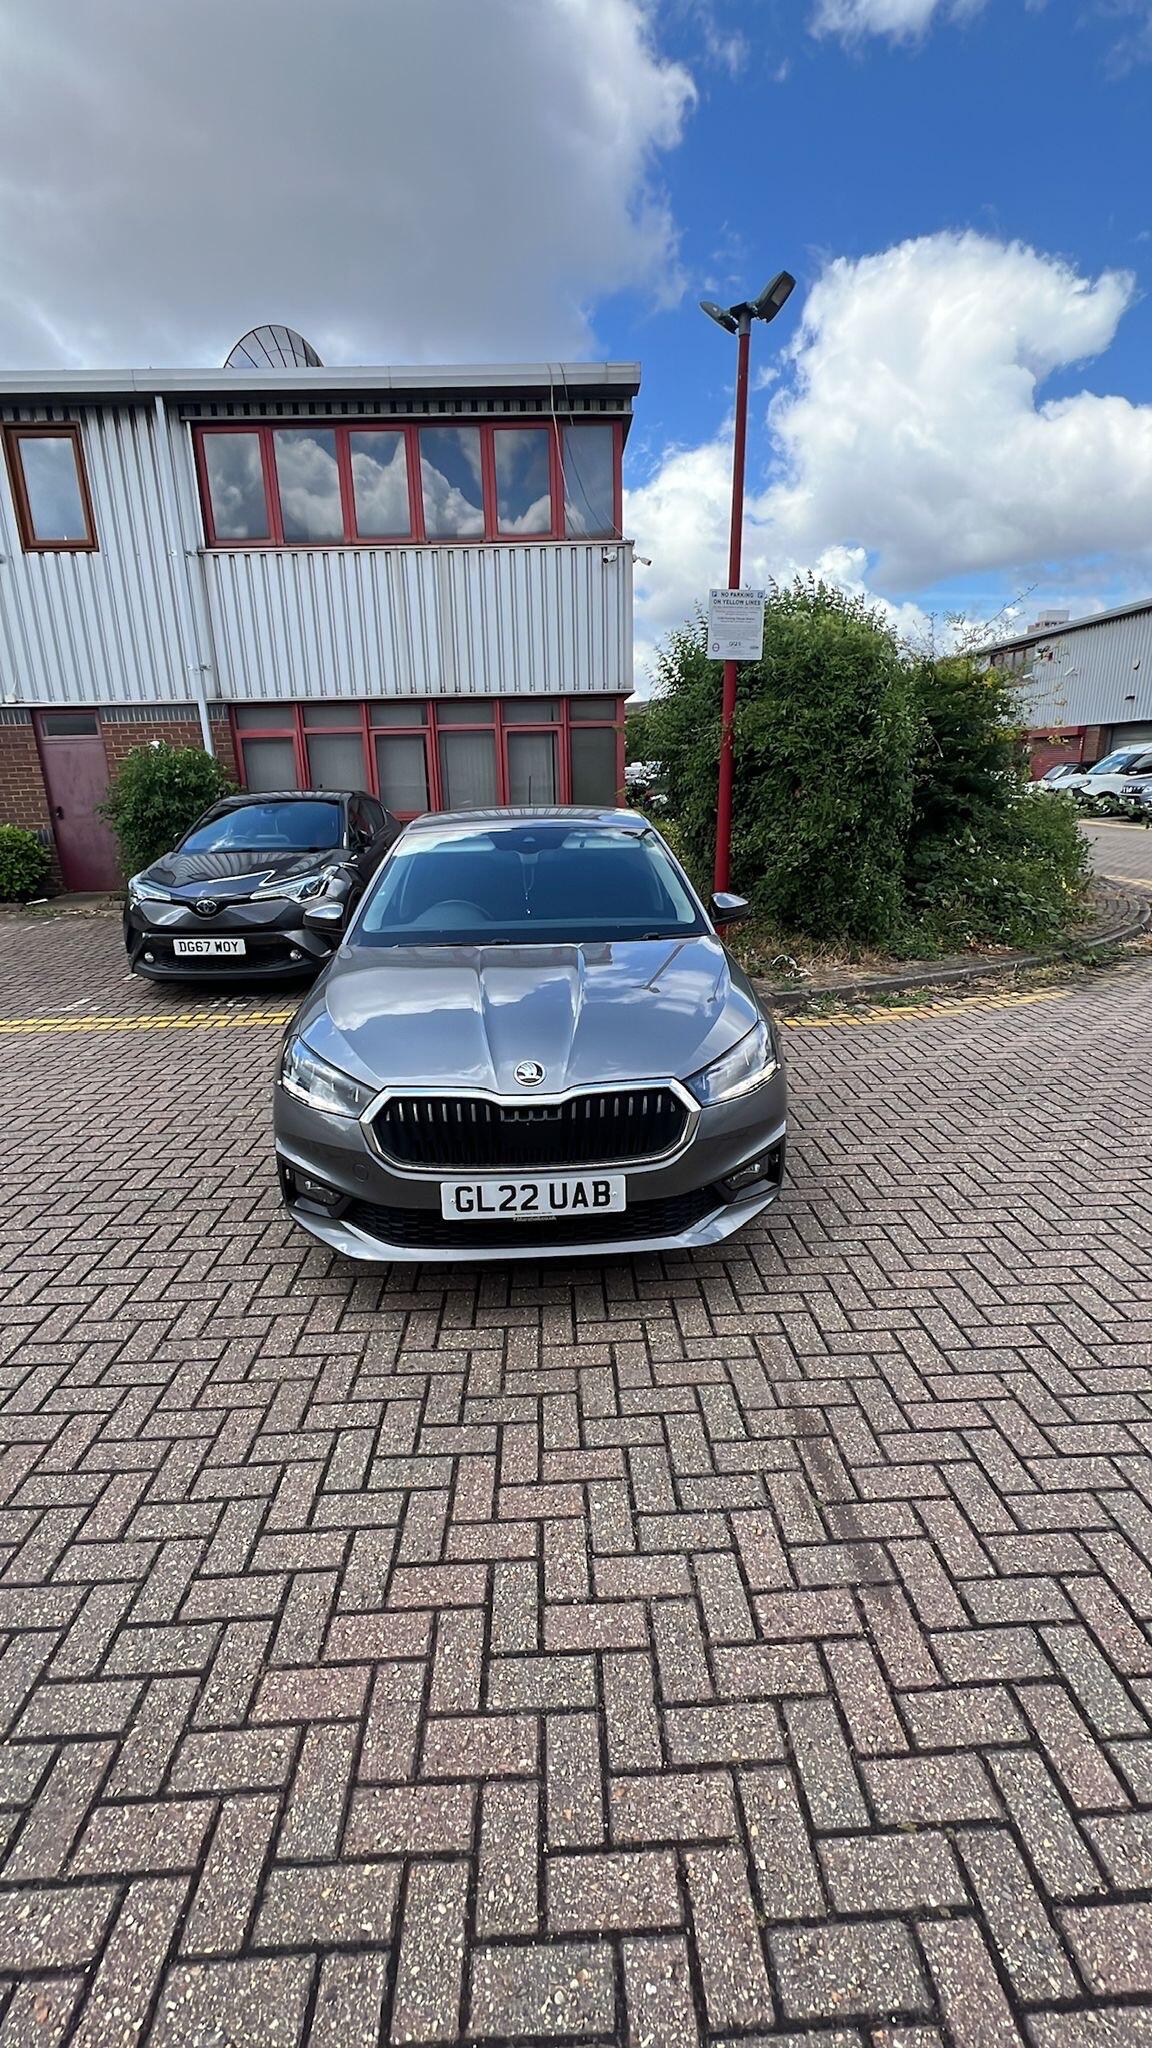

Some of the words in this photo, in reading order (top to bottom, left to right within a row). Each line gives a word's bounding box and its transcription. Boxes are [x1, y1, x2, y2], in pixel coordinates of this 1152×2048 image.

[178, 941, 211, 952] DG67
[455, 1184, 539, 1213] GL22
[549, 1180, 611, 1210] UAB
